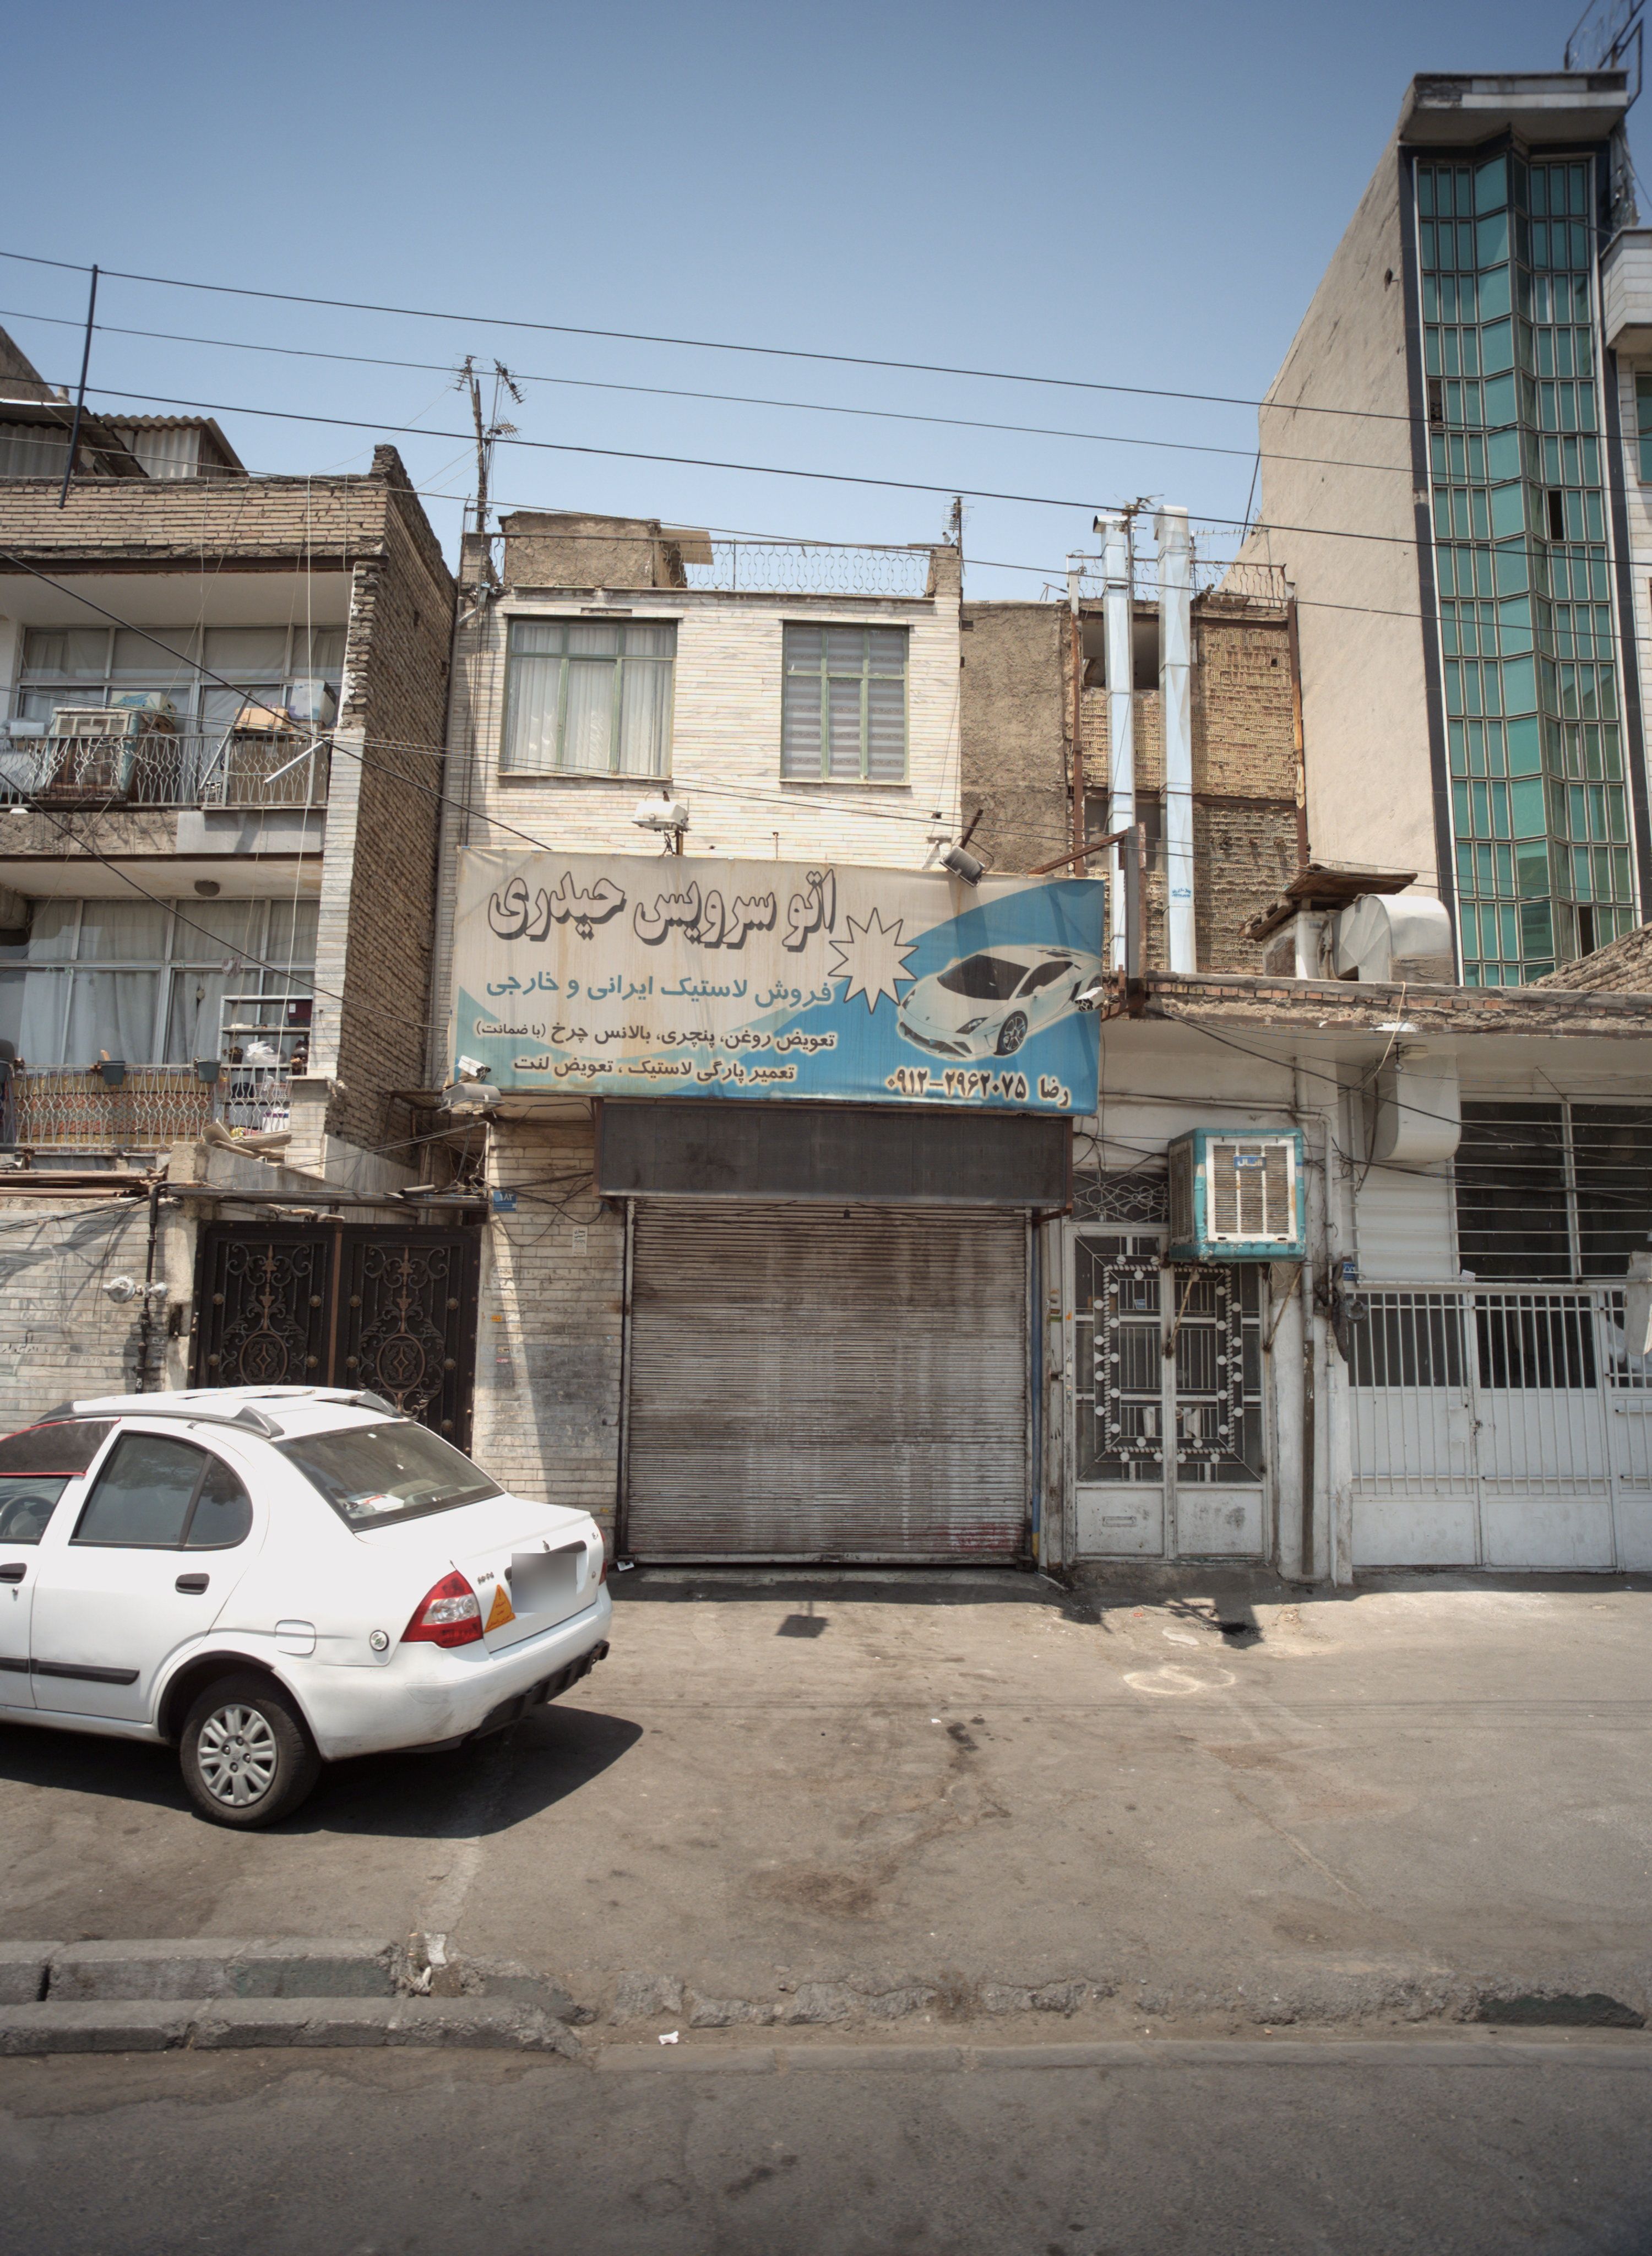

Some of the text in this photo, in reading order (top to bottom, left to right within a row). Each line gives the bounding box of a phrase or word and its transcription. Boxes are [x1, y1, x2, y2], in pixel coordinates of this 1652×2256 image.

[488, 869, 836, 953] اتو سرویس حیدری
[486, 971, 832, 1008] فروش لاستیک ایرانی و خارجی
[476, 1021, 529, 1037] ضمانت)
[531, 1023, 546, 1038] (با
[551, 1022, 589, 1044] چرخ
[594, 1024, 651, 1045] بالانس
[776, 1031, 835, 1053] تعویض
[514, 1056, 550, 1070] لنت
[554, 1057, 613, 1078] تعویض
[628, 1061, 692, 1078] لاستیک
[696, 1061, 745, 1084] پارگی
[748, 1065, 795, 1083] تعمیر
[1040, 1076, 1069, 1107] رضا
